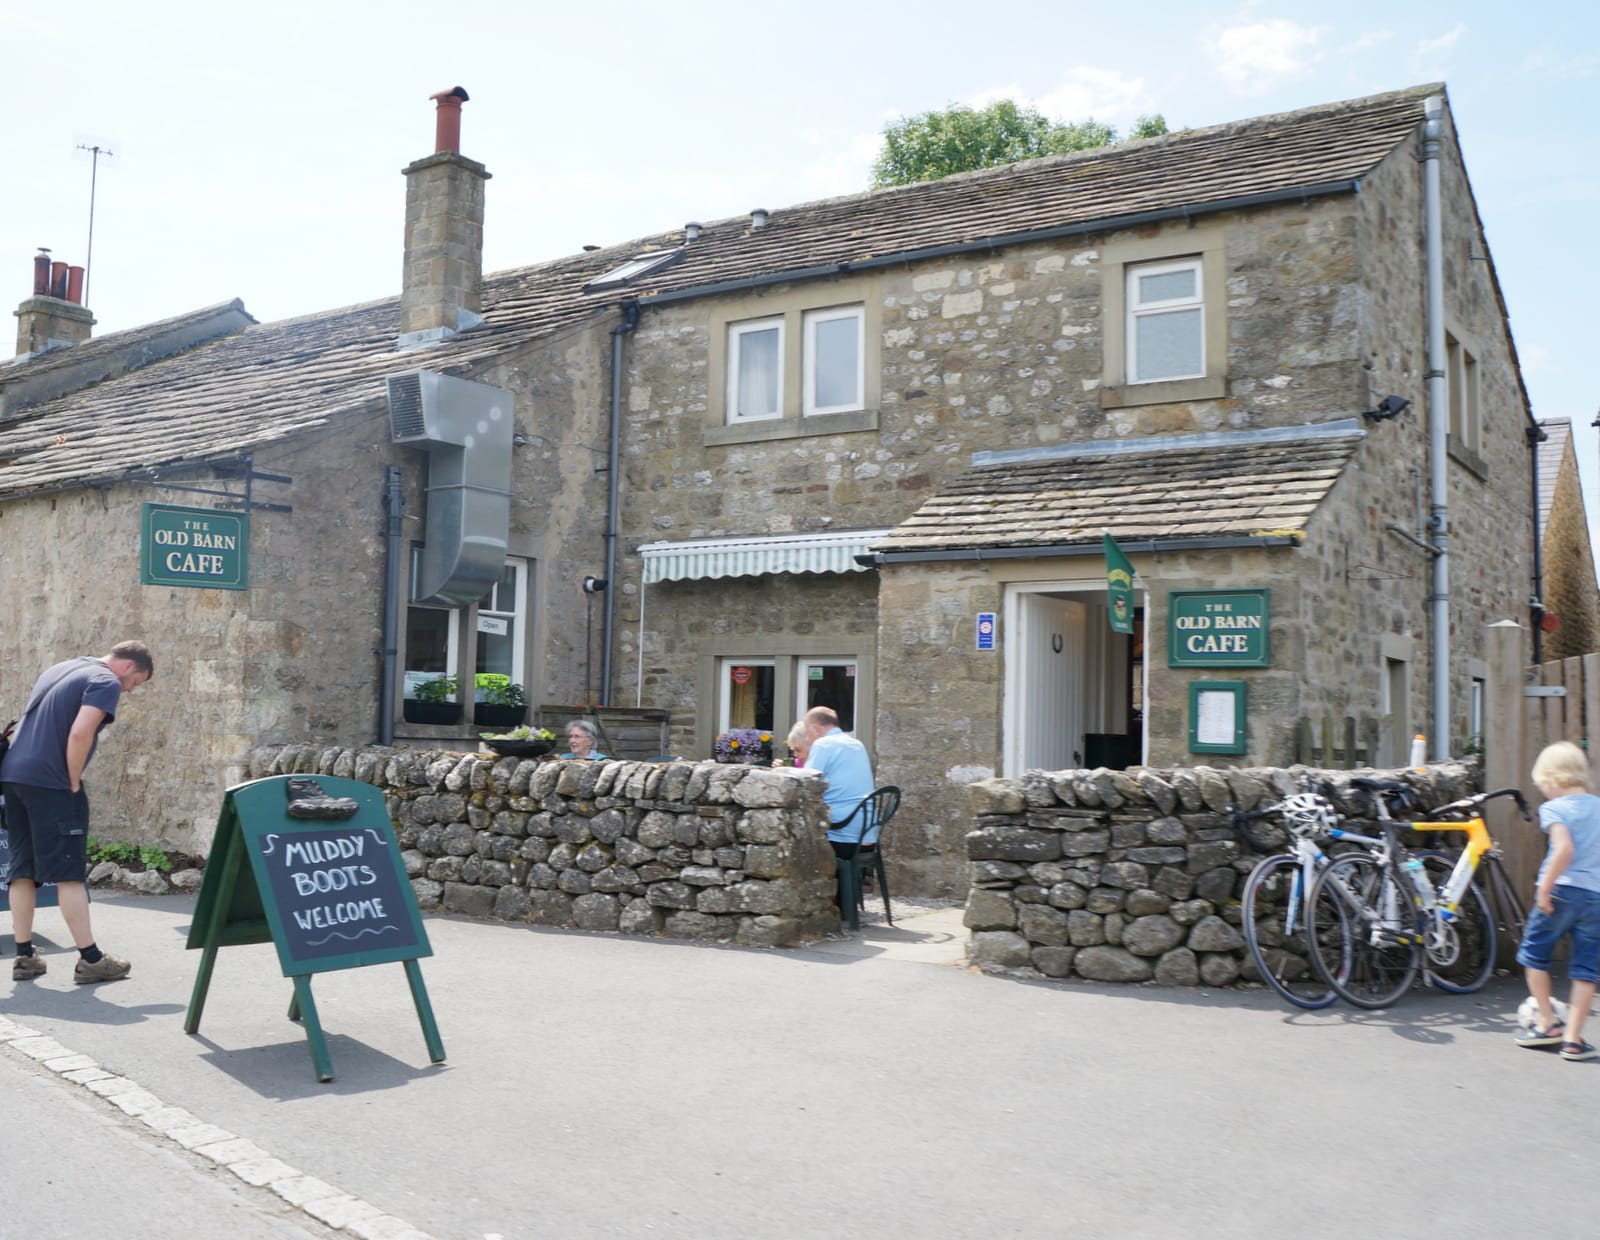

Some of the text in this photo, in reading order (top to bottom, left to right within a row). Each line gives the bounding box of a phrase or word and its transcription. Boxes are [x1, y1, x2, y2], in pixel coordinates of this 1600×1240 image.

[184, 520, 209, 531] THE
[155, 529, 236, 550] OLD BARN
[166, 551, 224, 575] CAFE
[1205, 603, 1232, 612] THE
[482, 620, 499, 629] Open
[1176, 615, 1262, 629] OLD BARN
[1187, 634, 1249, 653] CAFE
[285, 835, 364, 867] MUDDY
[290, 865, 377, 896] BOOTS
[292, 898, 387, 930] WELCOME
